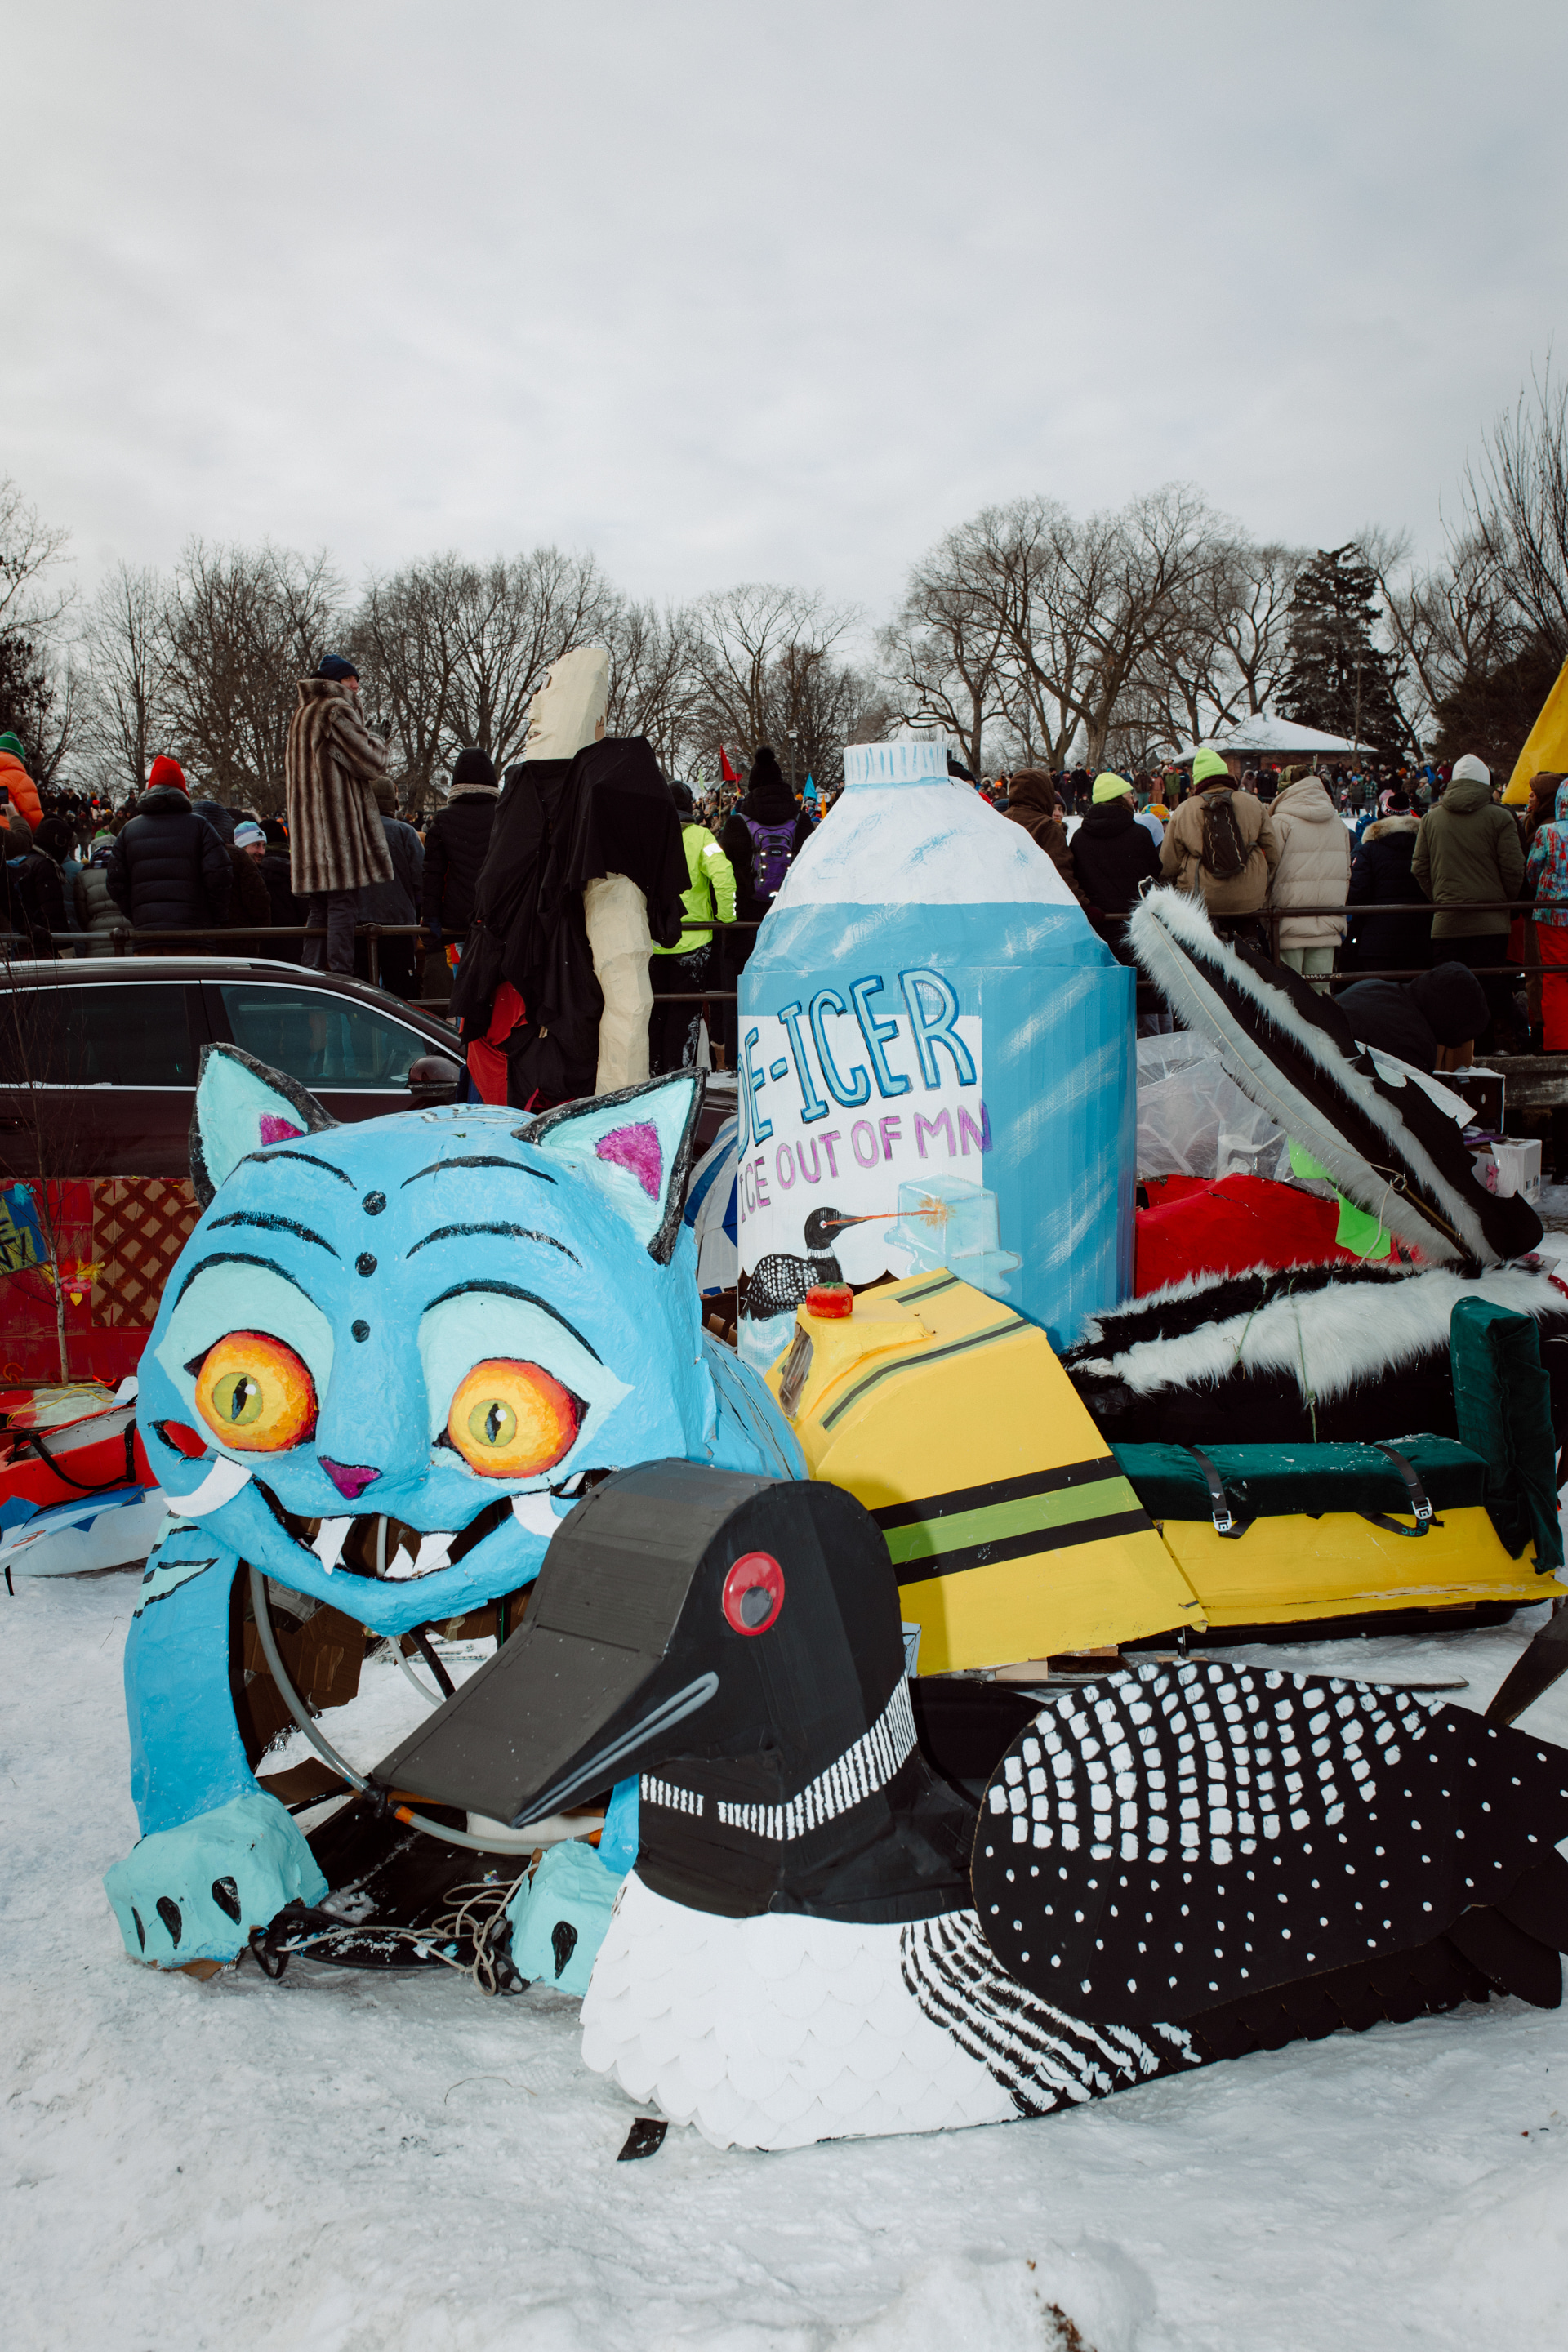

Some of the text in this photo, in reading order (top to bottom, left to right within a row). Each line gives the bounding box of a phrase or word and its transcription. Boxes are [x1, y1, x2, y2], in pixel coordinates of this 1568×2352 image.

[739, 1098, 994, 1223] ICE OUT OF MN
